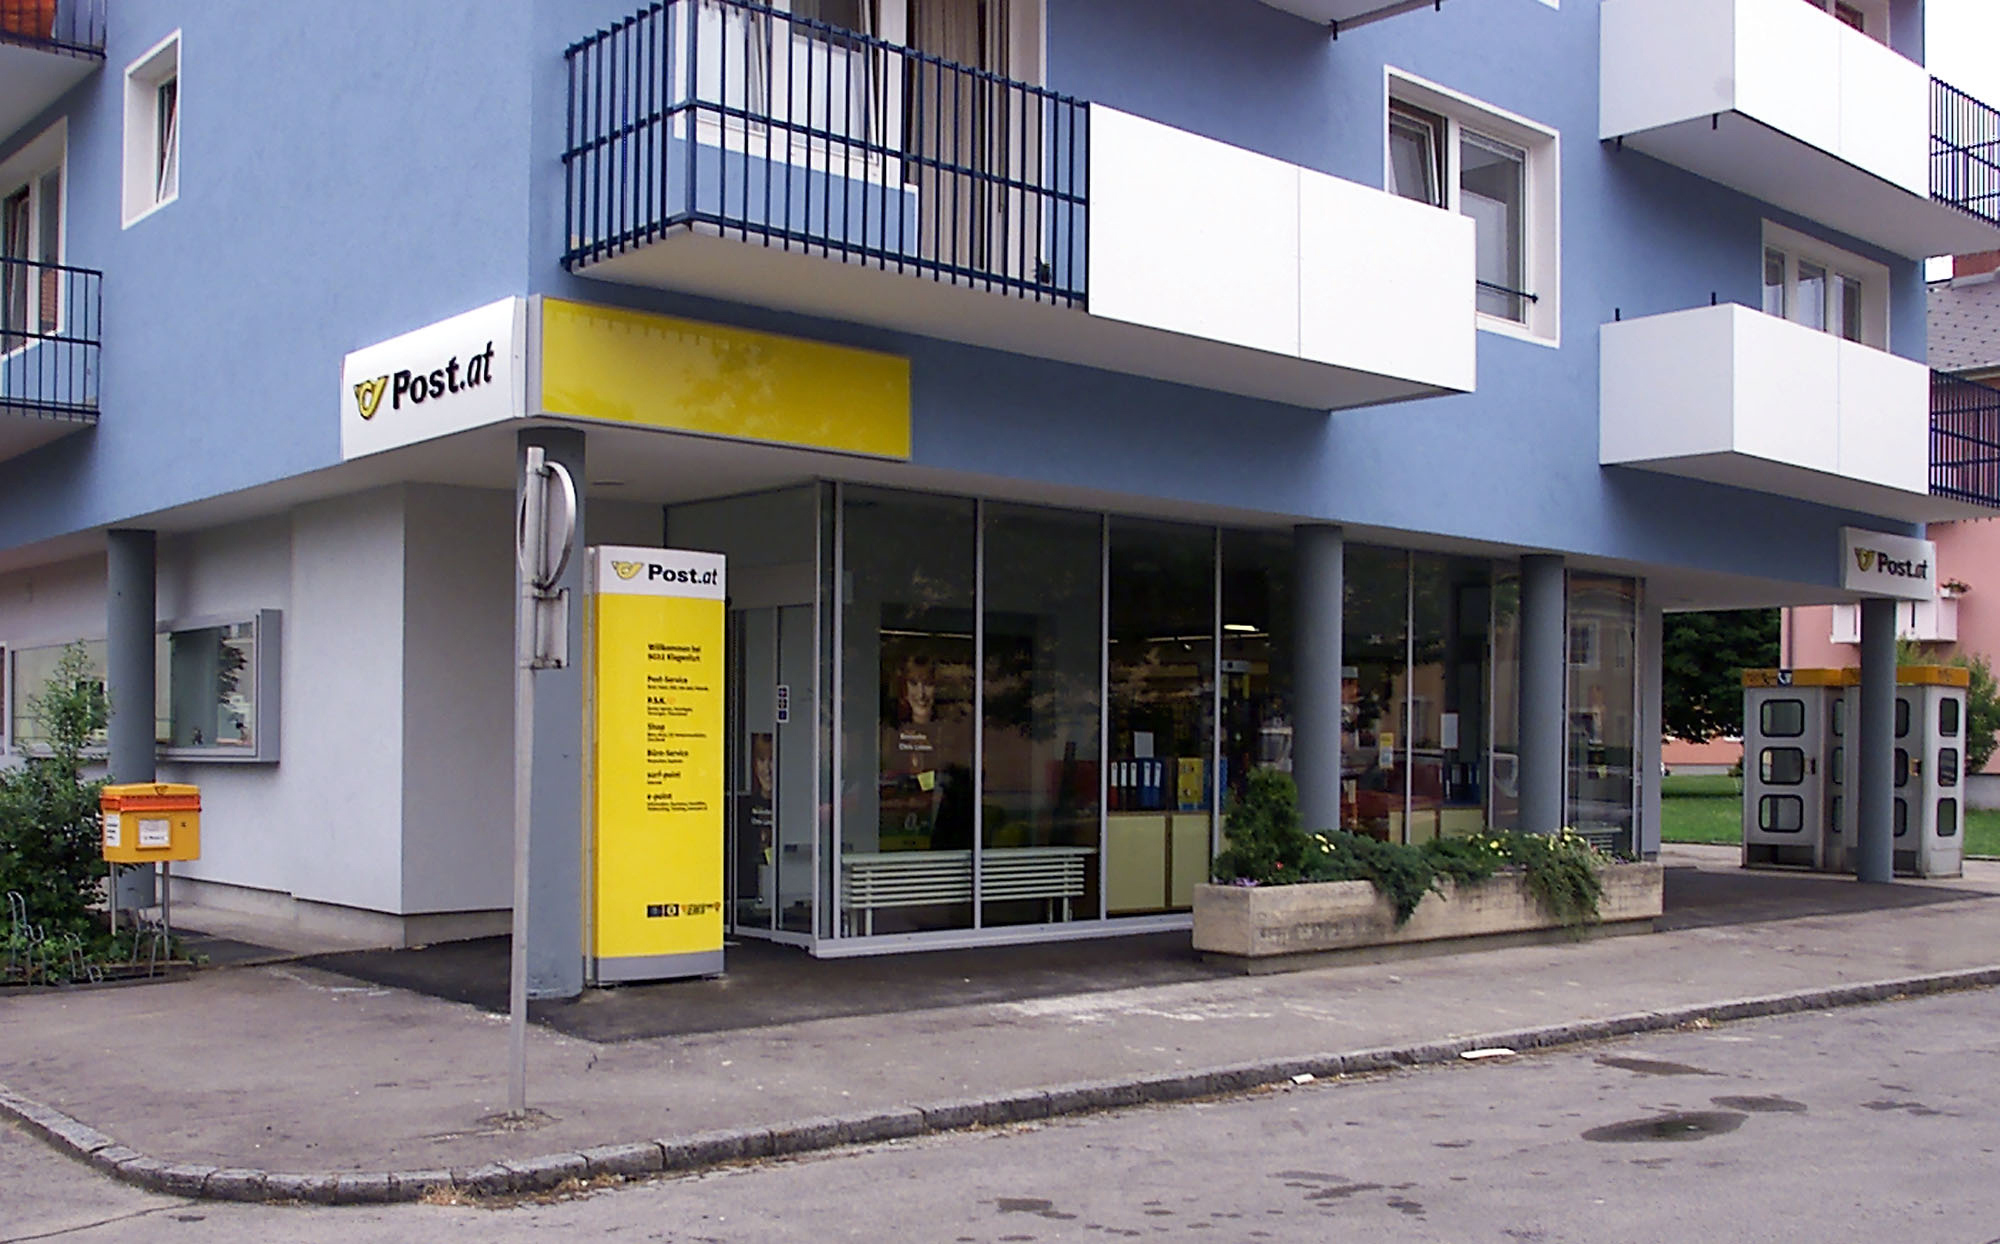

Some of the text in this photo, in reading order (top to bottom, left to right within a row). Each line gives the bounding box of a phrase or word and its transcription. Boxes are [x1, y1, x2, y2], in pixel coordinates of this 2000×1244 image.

[393, 341, 494, 410] Post.at
[648, 564, 718, 585] Post.at
[1877, 552, 1928, 580] Post.at
[648, 723, 665, 732] Shop
